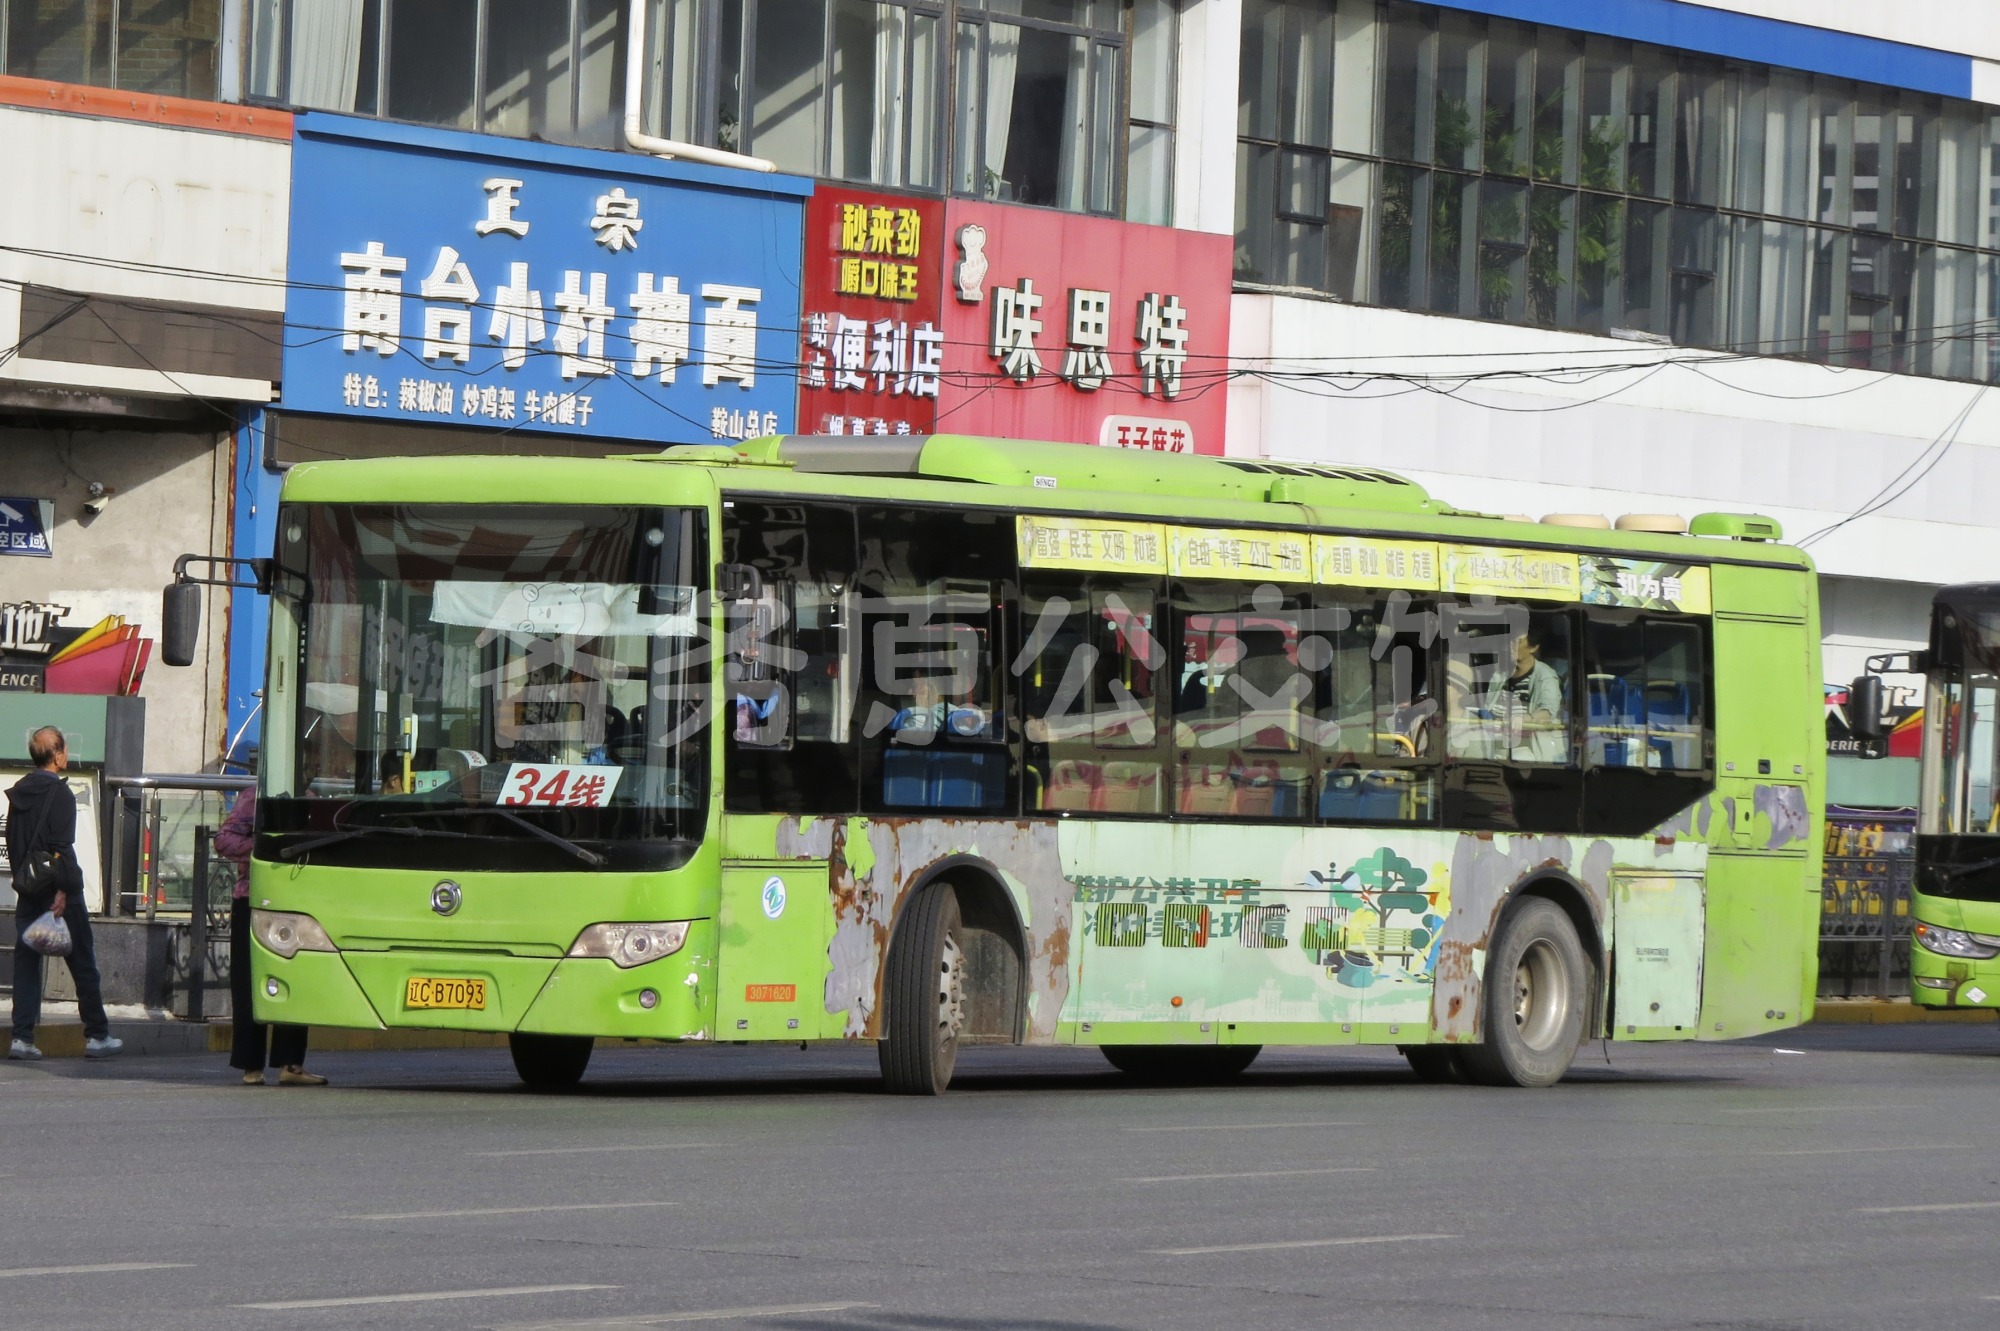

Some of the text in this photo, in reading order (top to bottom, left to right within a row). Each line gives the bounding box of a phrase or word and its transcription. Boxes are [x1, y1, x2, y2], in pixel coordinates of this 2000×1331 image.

[475, 178, 644, 252] 正宗
[842, 204, 921, 257] 秒来劲
[831, 313, 944, 397] 便利店
[990, 278, 1189, 397] 味思特
[398, 377, 454, 414] 辣椒油
[461, 383, 516, 420] 炒鸡架
[711, 407, 778, 440] 鞍山总店
[1036, 527, 1157, 562] 富强 民主 文明 和谐
[1188, 538, 1210, 566] 自由
[1219, 539, 1240, 568] 平等
[1250, 541, 1271, 568] 公正
[1332, 546, 1431, 579] 爱国 敬业 诚信 友善
[1616, 572, 1682, 601] 和为贵
[505, 767, 605, 807] 34线
